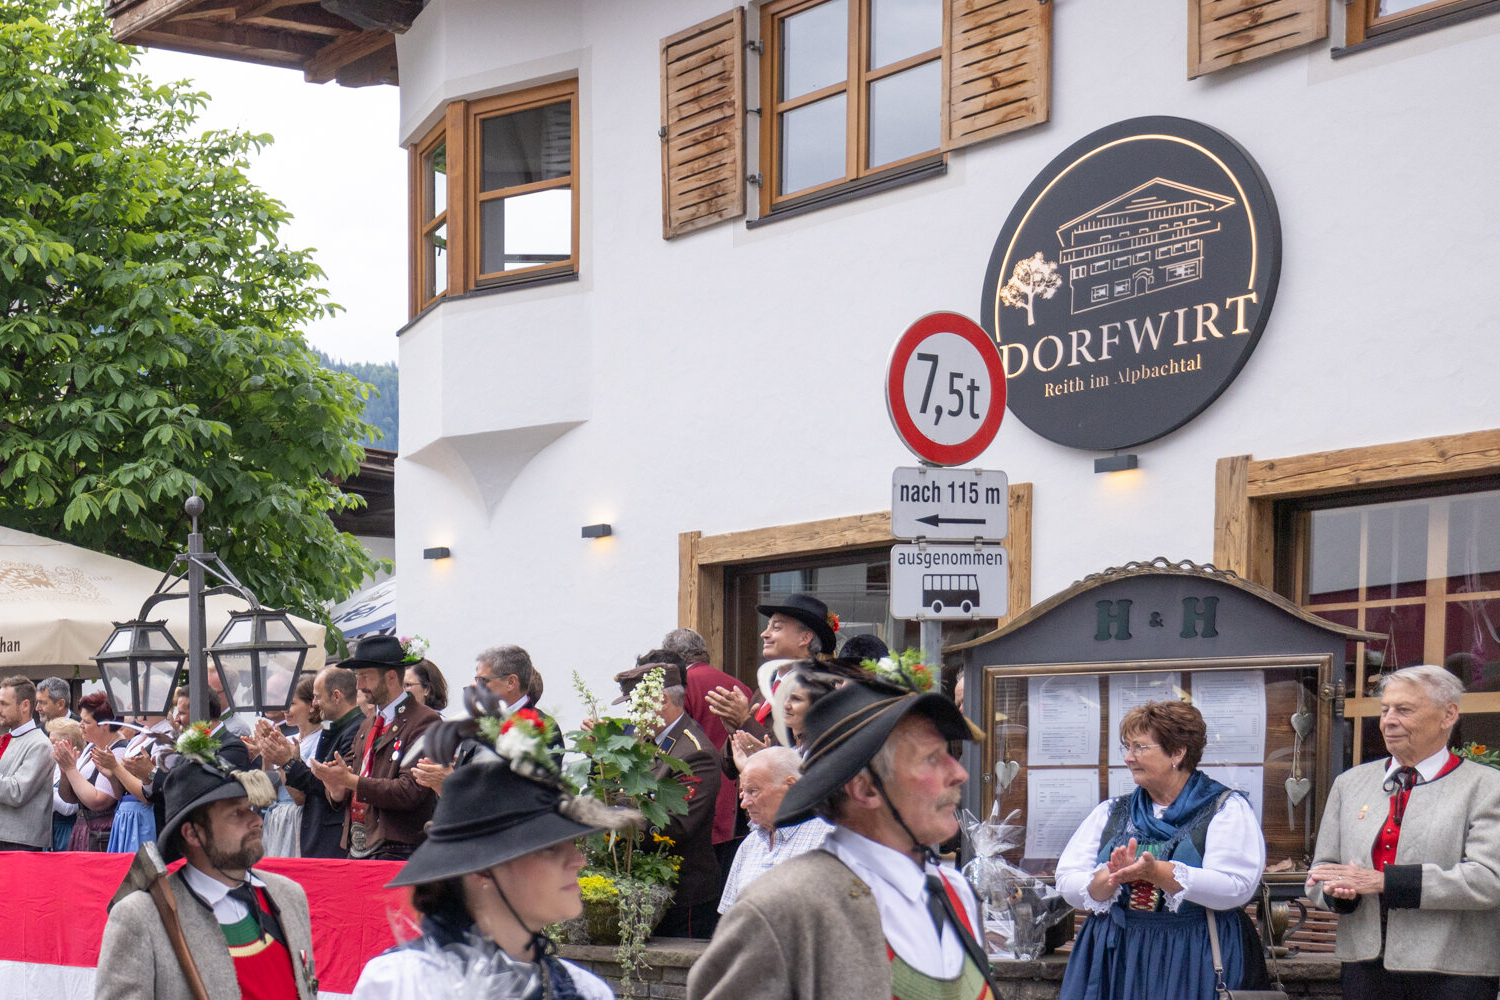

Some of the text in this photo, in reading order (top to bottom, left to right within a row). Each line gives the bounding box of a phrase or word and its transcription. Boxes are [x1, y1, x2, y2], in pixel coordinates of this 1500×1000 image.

[1000, 291, 1258, 379] DORFWIRT
[1044, 353, 1202, 398] Reith im Alpbachtal
[900, 480, 1000, 505] nach 115 m
[898, 552, 1003, 569] ausgenommen
[1094, 596, 1220, 641] H & H
